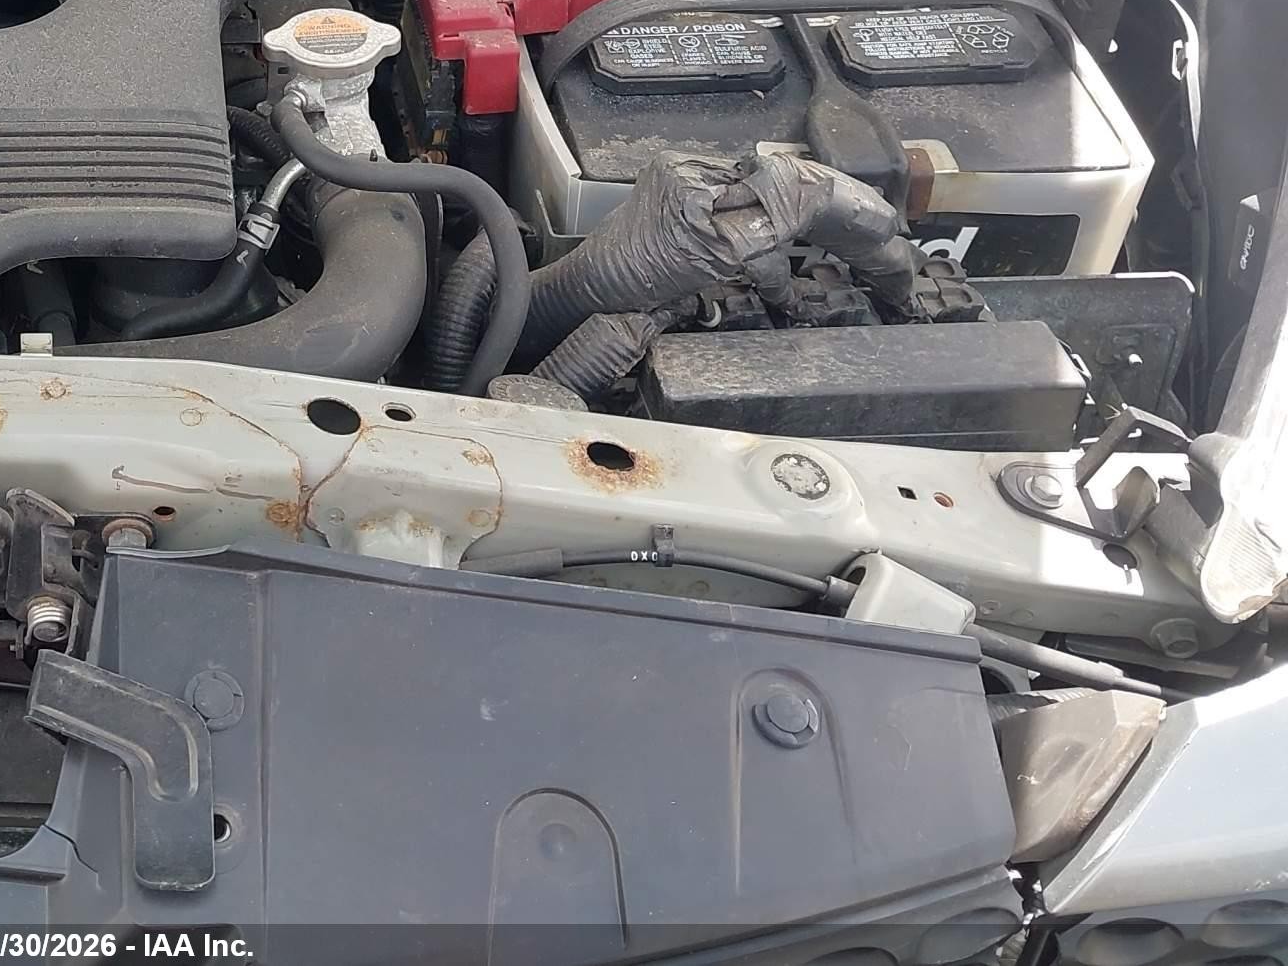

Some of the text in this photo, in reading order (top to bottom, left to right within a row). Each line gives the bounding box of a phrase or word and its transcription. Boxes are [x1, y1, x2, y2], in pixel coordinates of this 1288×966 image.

[619, 23, 746, 35] DANGER / POISON
